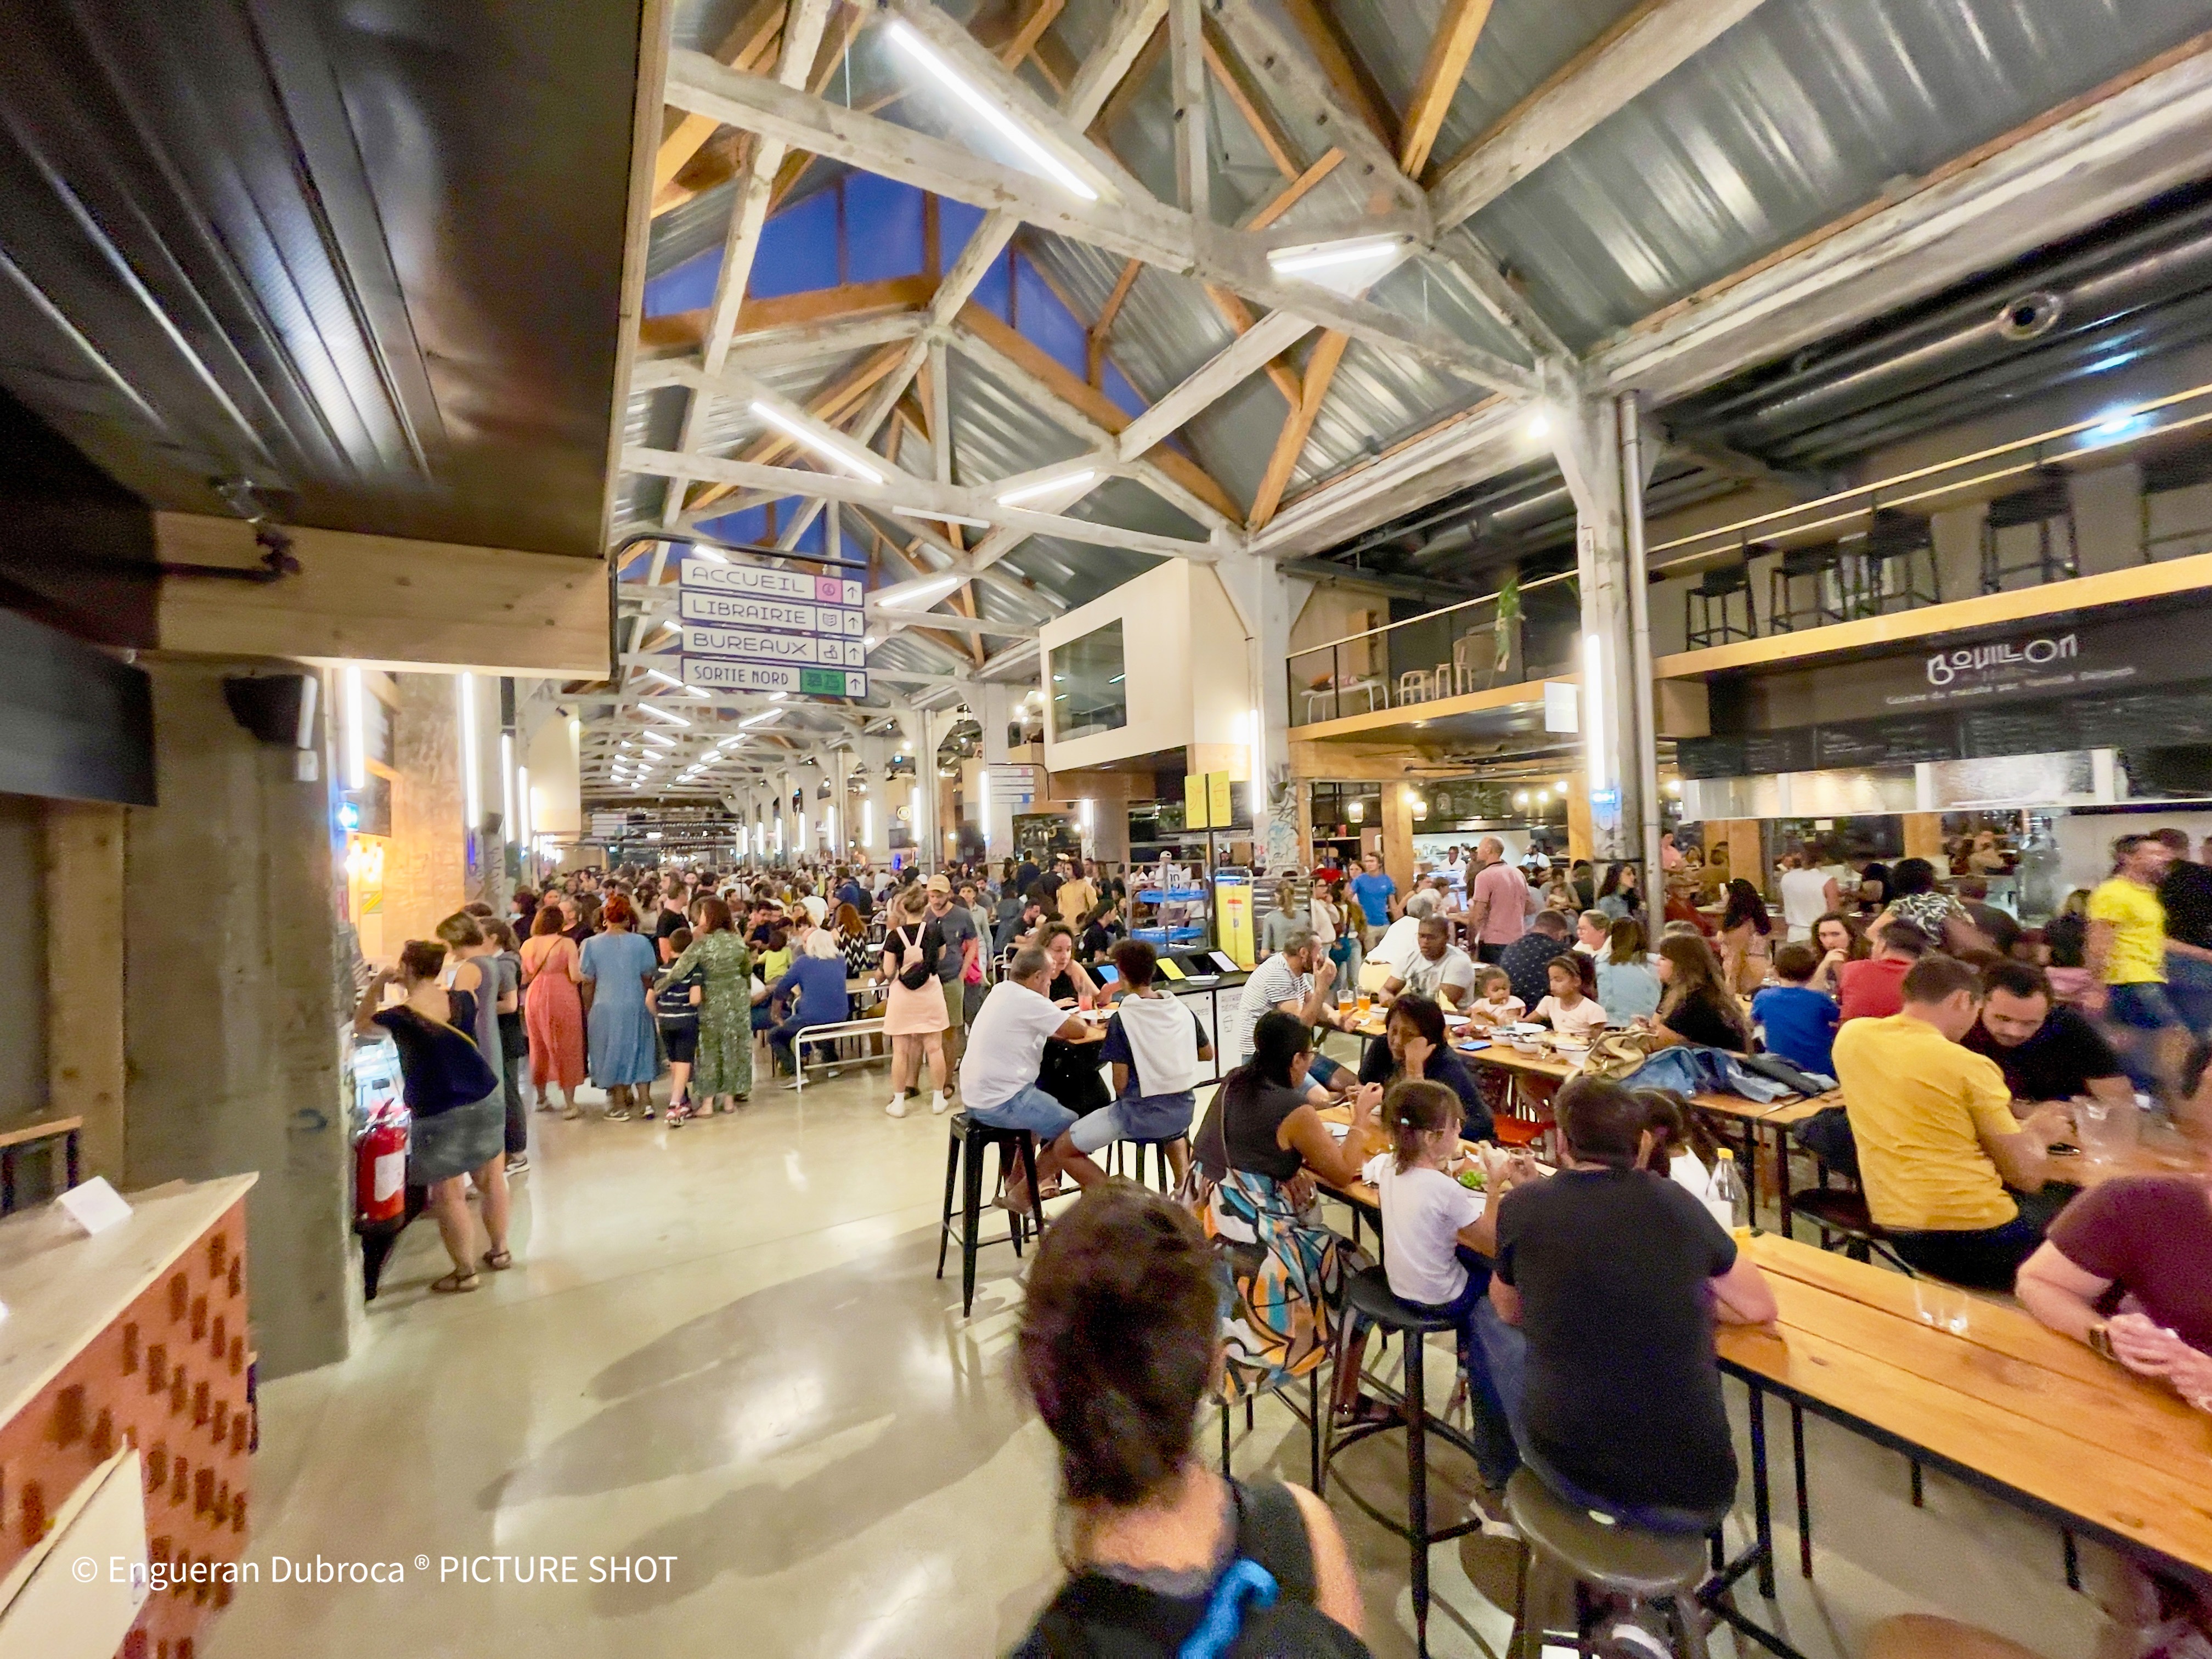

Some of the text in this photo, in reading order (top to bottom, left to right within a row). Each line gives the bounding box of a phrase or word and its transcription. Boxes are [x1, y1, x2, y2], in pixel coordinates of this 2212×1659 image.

[692, 566, 805, 593] ACCUEIL
[692, 598, 806, 624] LIBRAIRIE
[693, 633, 808, 656] BUREAUX
[694, 665, 788, 685] SORTIE NORD
